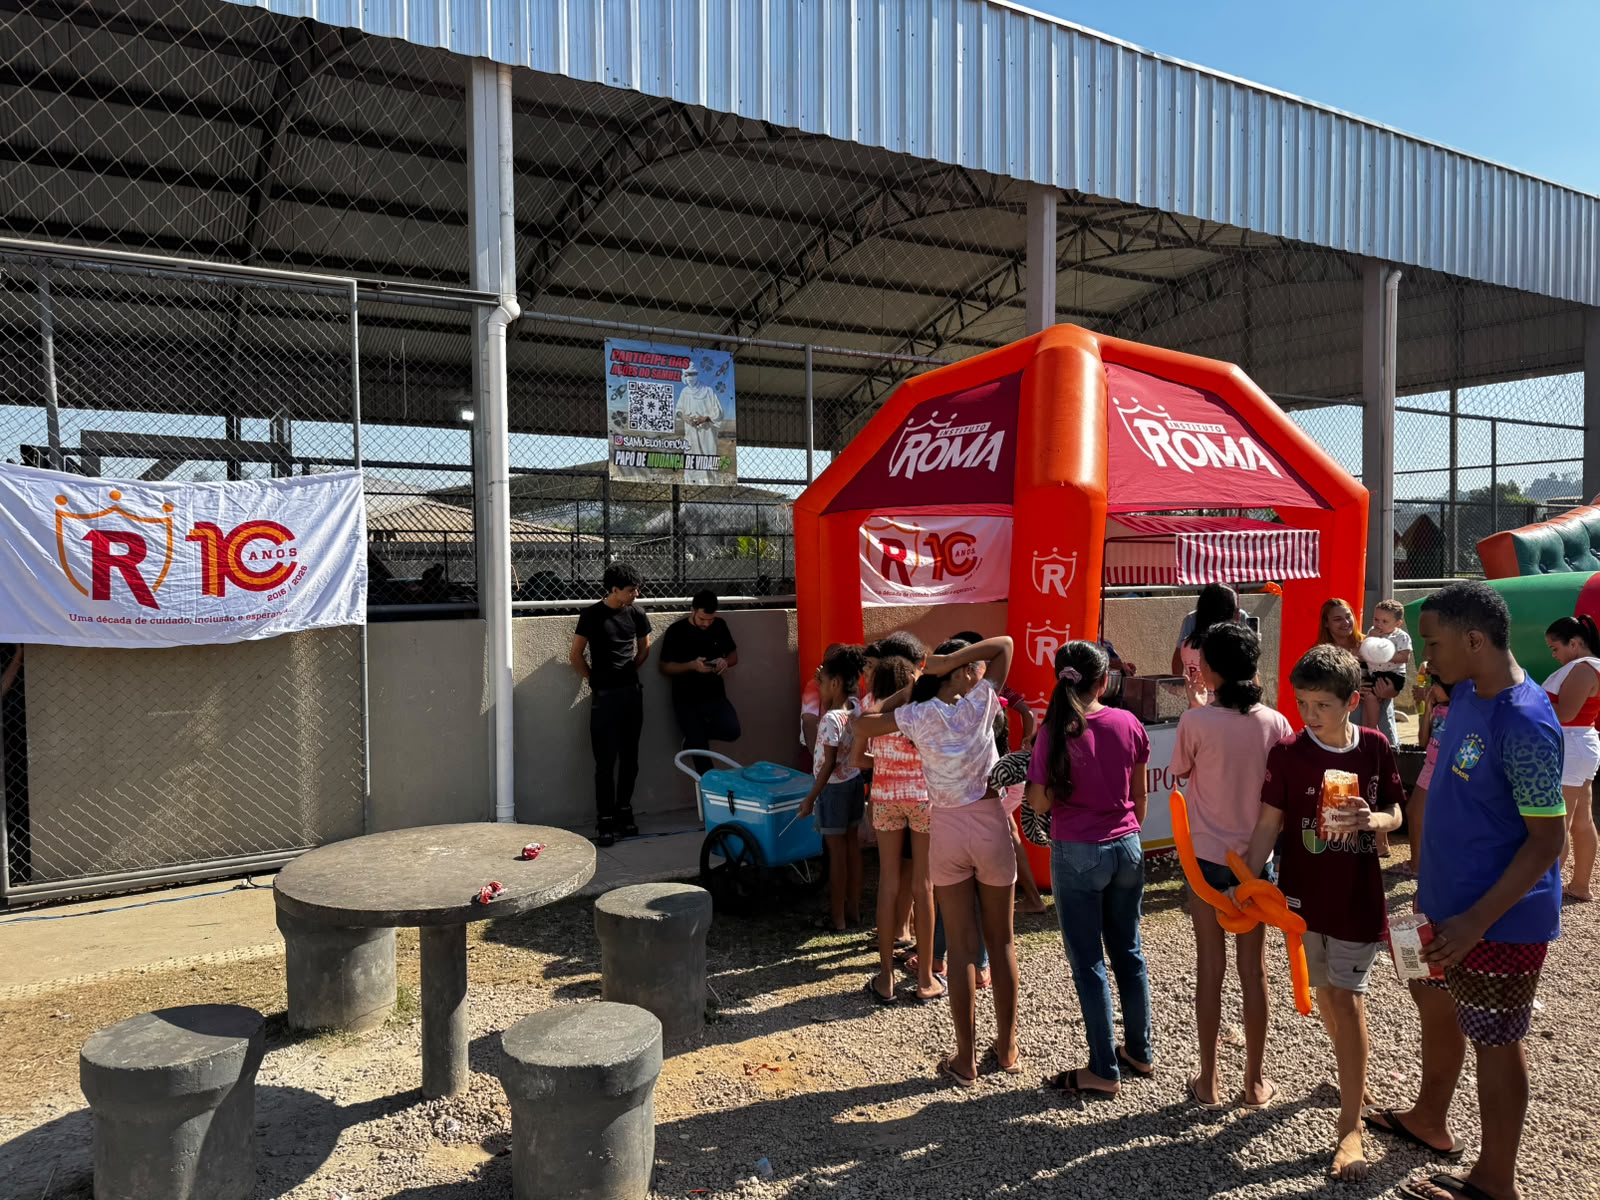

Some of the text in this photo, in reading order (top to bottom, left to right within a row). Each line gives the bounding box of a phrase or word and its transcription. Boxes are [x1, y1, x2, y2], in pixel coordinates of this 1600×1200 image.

[611, 349, 690, 369] PARTICIPE DAS
[639, 366, 650, 378] DO
[651, 368, 682, 381] SAMUEL
[939, 424, 987, 437] INSTITUTO
[1168, 421, 1222, 433] INSTITUTO
[889, 430, 1005, 480] ROMA
[1134, 418, 1283, 479] ROMA
[616, 451, 635, 466] PAPO
[636, 452, 646, 467] DE
[647, 453, 684, 470] MUDANÇA
[686, 456, 695, 469] DE
[249, 548, 298, 560] ANOS
[879, 537, 912, 587] R
[81, 529, 161, 610] R
[1040, 563, 1068, 597] R
[267, 589, 287, 602] 2016
[69, 613, 93, 623] Uma
[96, 615, 132, 625] década
[135, 616, 147, 625] de
[150, 616, 193, 626] cuidado,
[194, 614, 236, 624] inclusão
[1034, 636, 1056, 667] R
